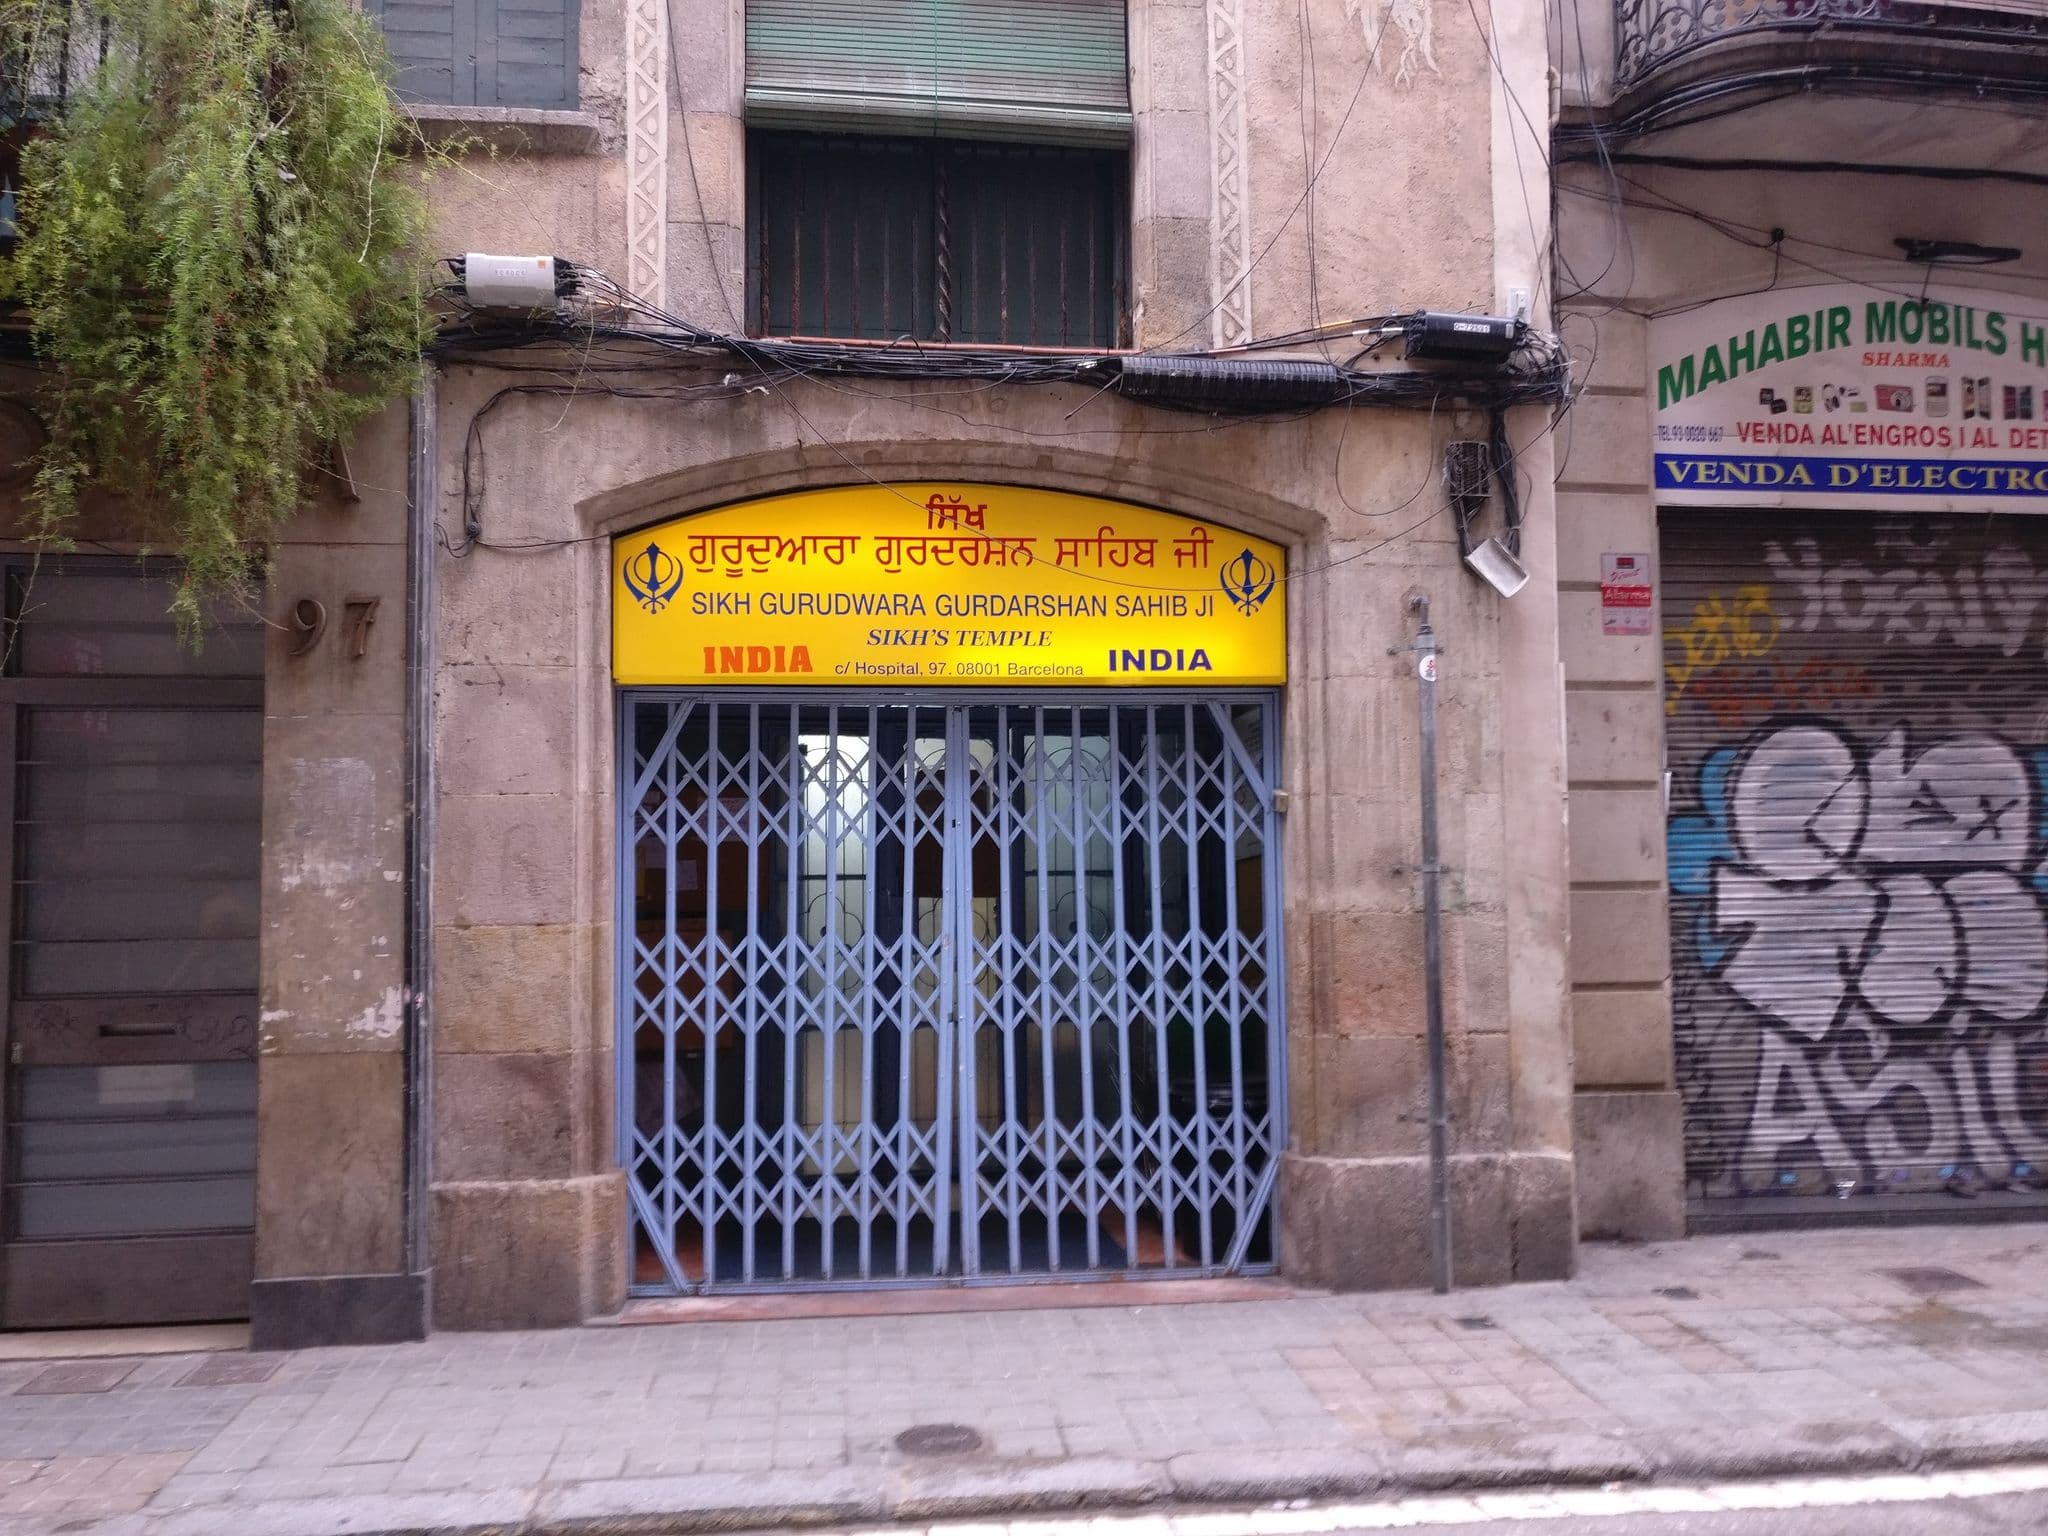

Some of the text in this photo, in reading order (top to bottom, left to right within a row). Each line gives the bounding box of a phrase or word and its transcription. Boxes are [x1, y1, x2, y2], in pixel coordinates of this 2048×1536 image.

[1658, 304, 1852, 411] MAHABIR
[1865, 300, 2007, 356] MOBILS
[1861, 351, 1951, 368] SHARMA
[1736, 421, 1814, 445] VENDA
[1663, 460, 1815, 486] VENDA
[925, 493, 988, 530] ਸਿੱਖ
[687, 535, 861, 577] ਗੁਰੂਦੁਆਰਾ
[1054, 525, 1158, 568] ਸਾਹਿਬ
[1172, 526, 1215, 568] ਜੀ
[691, 592, 1214, 617] SIKH GURUDWARA GURDARSHAN SAHIB JI
[288, 595, 384, 660] 97
[866, 628, 1053, 647] SIKH'S TEMPLE
[703, 645, 813, 673] INDIA
[834, 661, 851, 676] c/
[855, 661, 924, 677] Hospital,
[956, 664, 1001, 676] 08001
[1008, 664, 1085, 677] Barcelona
[1108, 649, 1213, 672] INDIA
